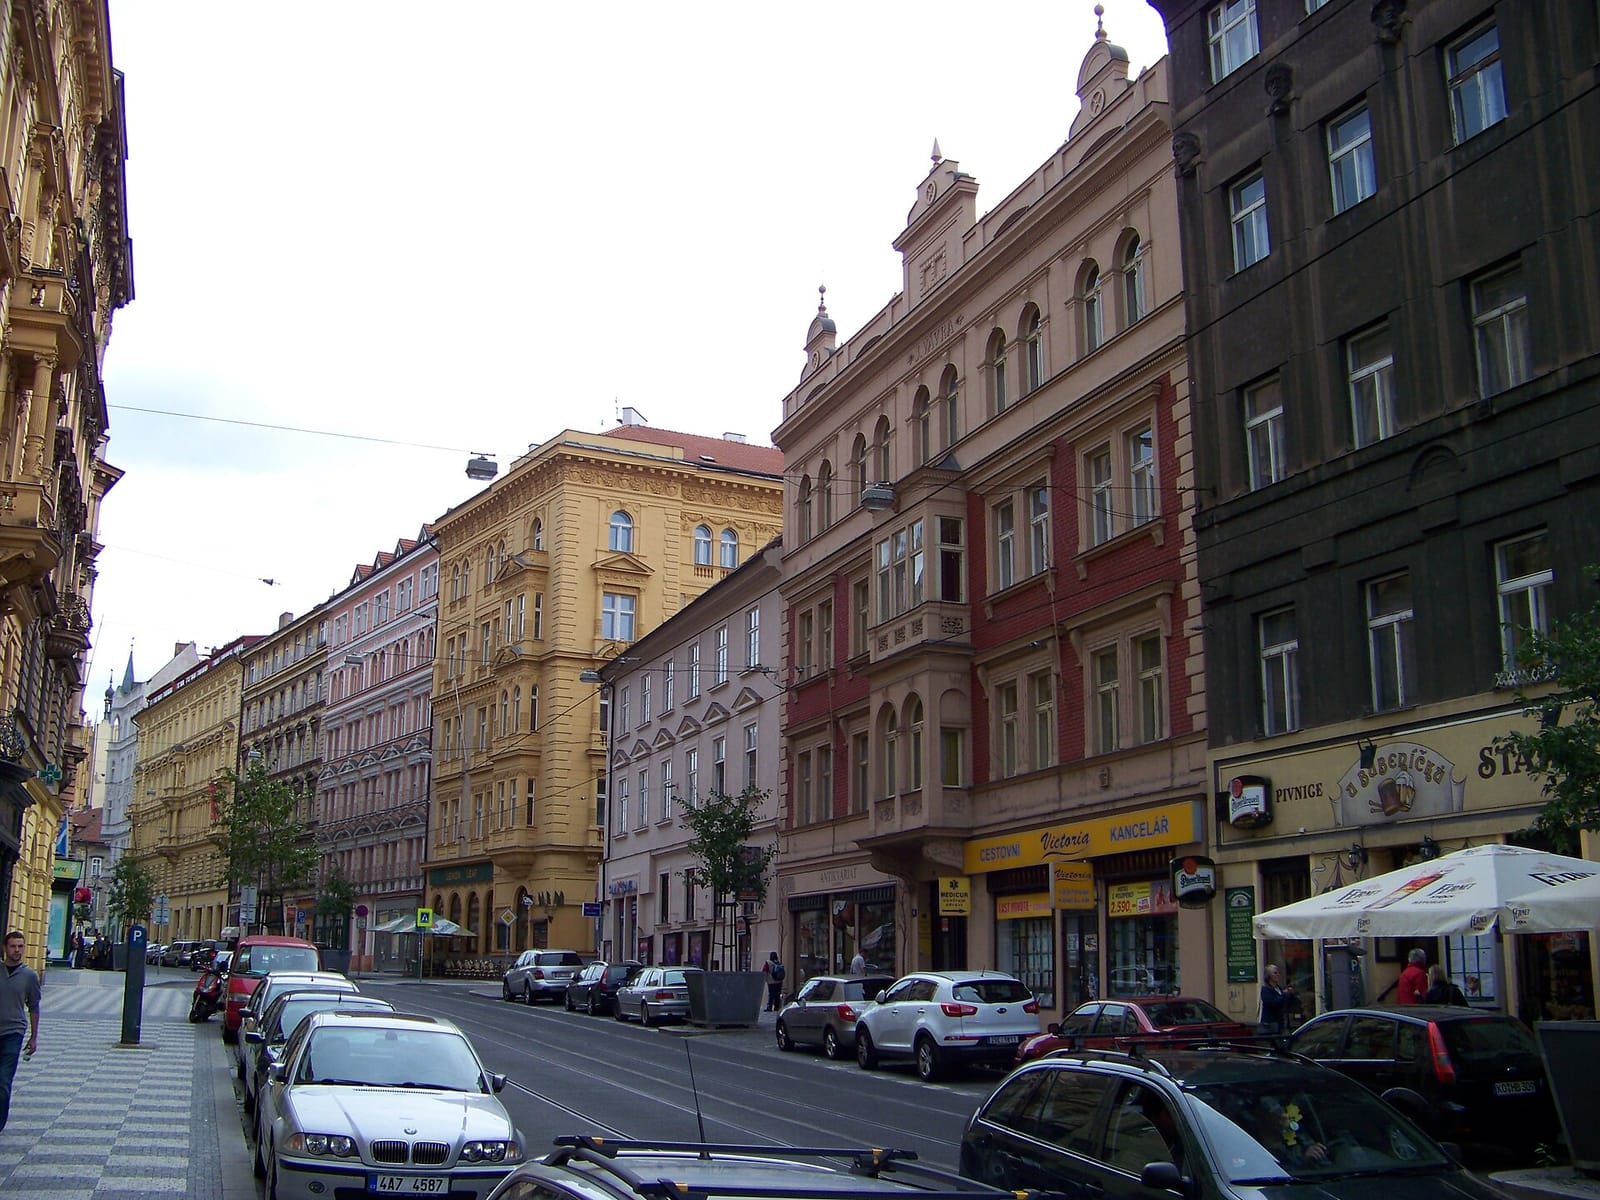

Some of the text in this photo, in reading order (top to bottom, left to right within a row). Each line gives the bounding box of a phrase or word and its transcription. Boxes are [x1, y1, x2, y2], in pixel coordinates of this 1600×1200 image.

[1041, 831, 1090, 851] Victoria
[1110, 816, 1169, 842] KANCELÁŘ
[1054, 869, 1091, 879] Victoria
[133, 930, 142, 942] P
[1352, 959, 1359, 971] P
[380, 1177, 444, 1192] 4A7 4587
